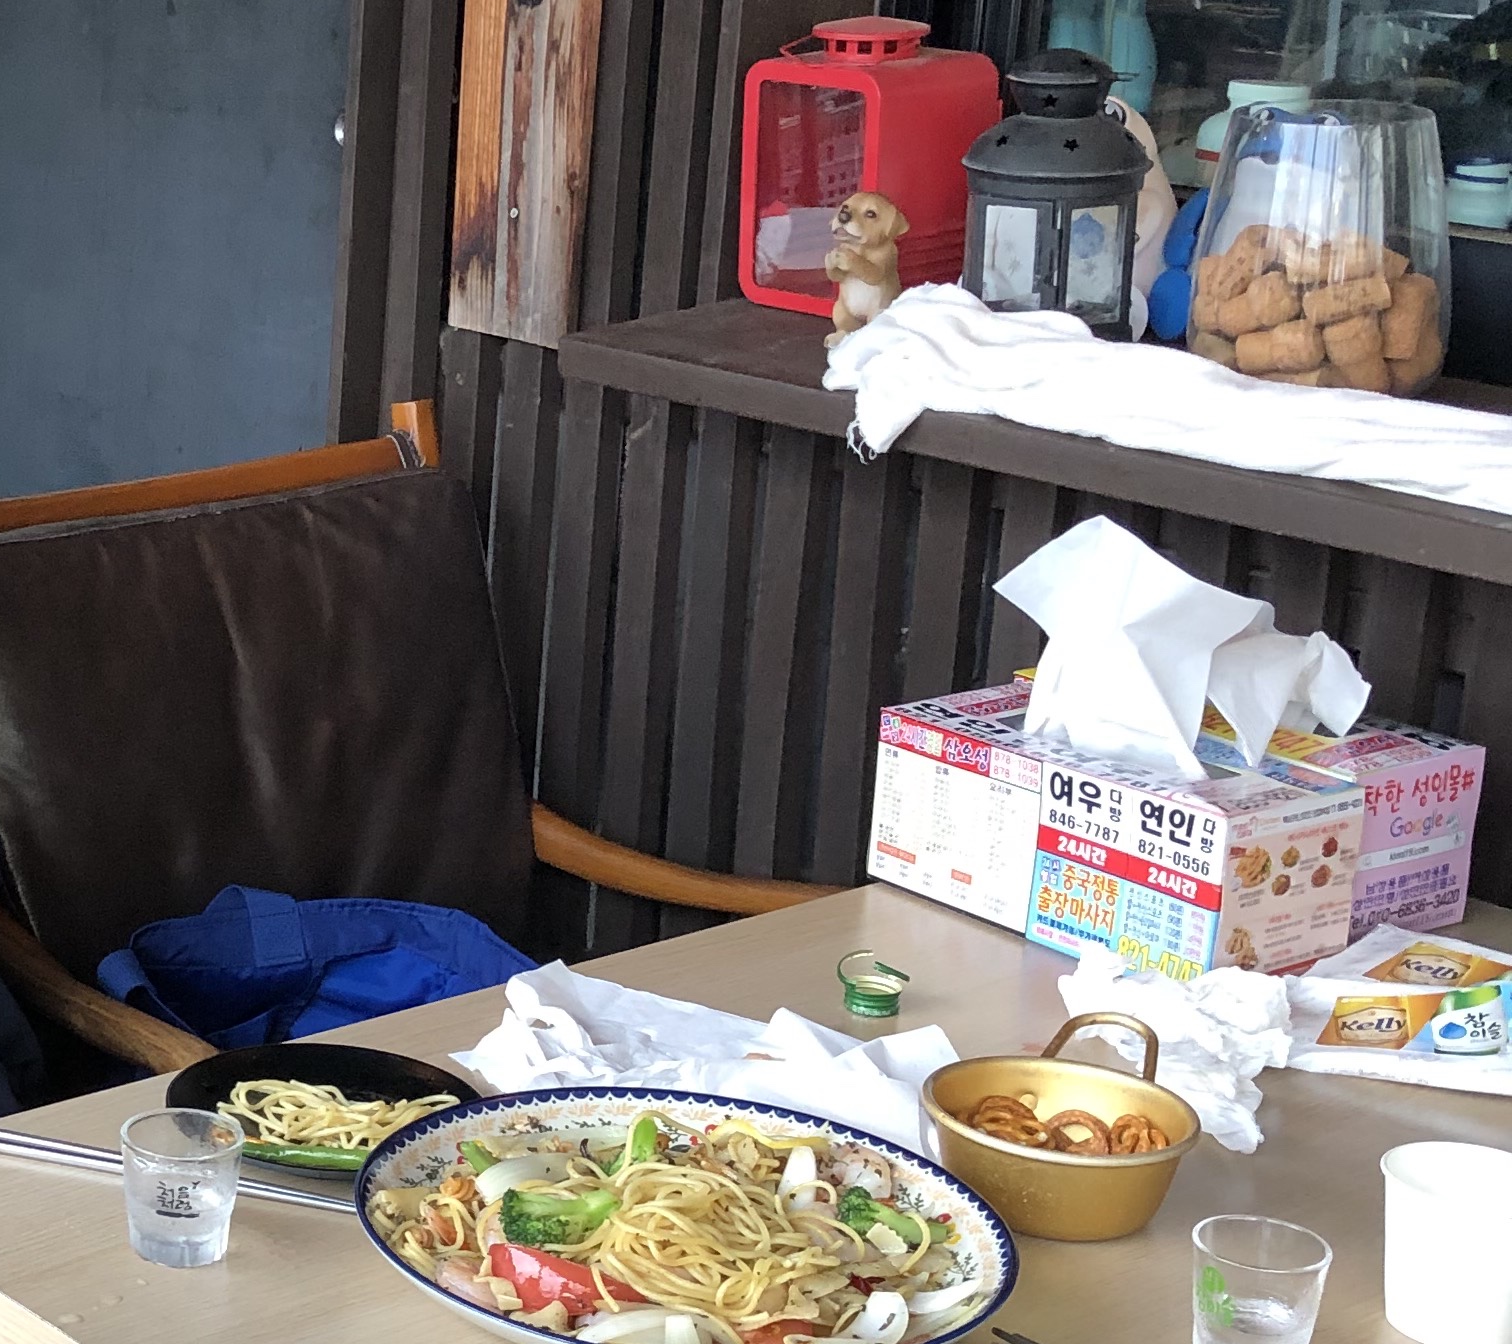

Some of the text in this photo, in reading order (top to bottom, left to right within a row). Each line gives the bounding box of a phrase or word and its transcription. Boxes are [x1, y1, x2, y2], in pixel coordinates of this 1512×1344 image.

[943, 736, 992, 772] 삼오성
[1050, 771, 1102, 814] 여우
[1049, 808, 1119, 844] 846-7787
[1140, 799, 1196, 848] 연인
[1390, 808, 1444, 838] Google
[1057, 834, 1108, 867] 24시간
[1138, 838, 1211, 876] 821-0556
[1062, 863, 1120, 907] 중국정통
[1147, 866, 1198, 900] 24시간
[1037, 884, 1115, 937] 출장마사지
[1399, 958, 1466, 981] Kelly
[1340, 1016, 1408, 1033] Kelly
[1464, 1011, 1490, 1029] 참
[1469, 1022, 1502, 1040] 이슬
